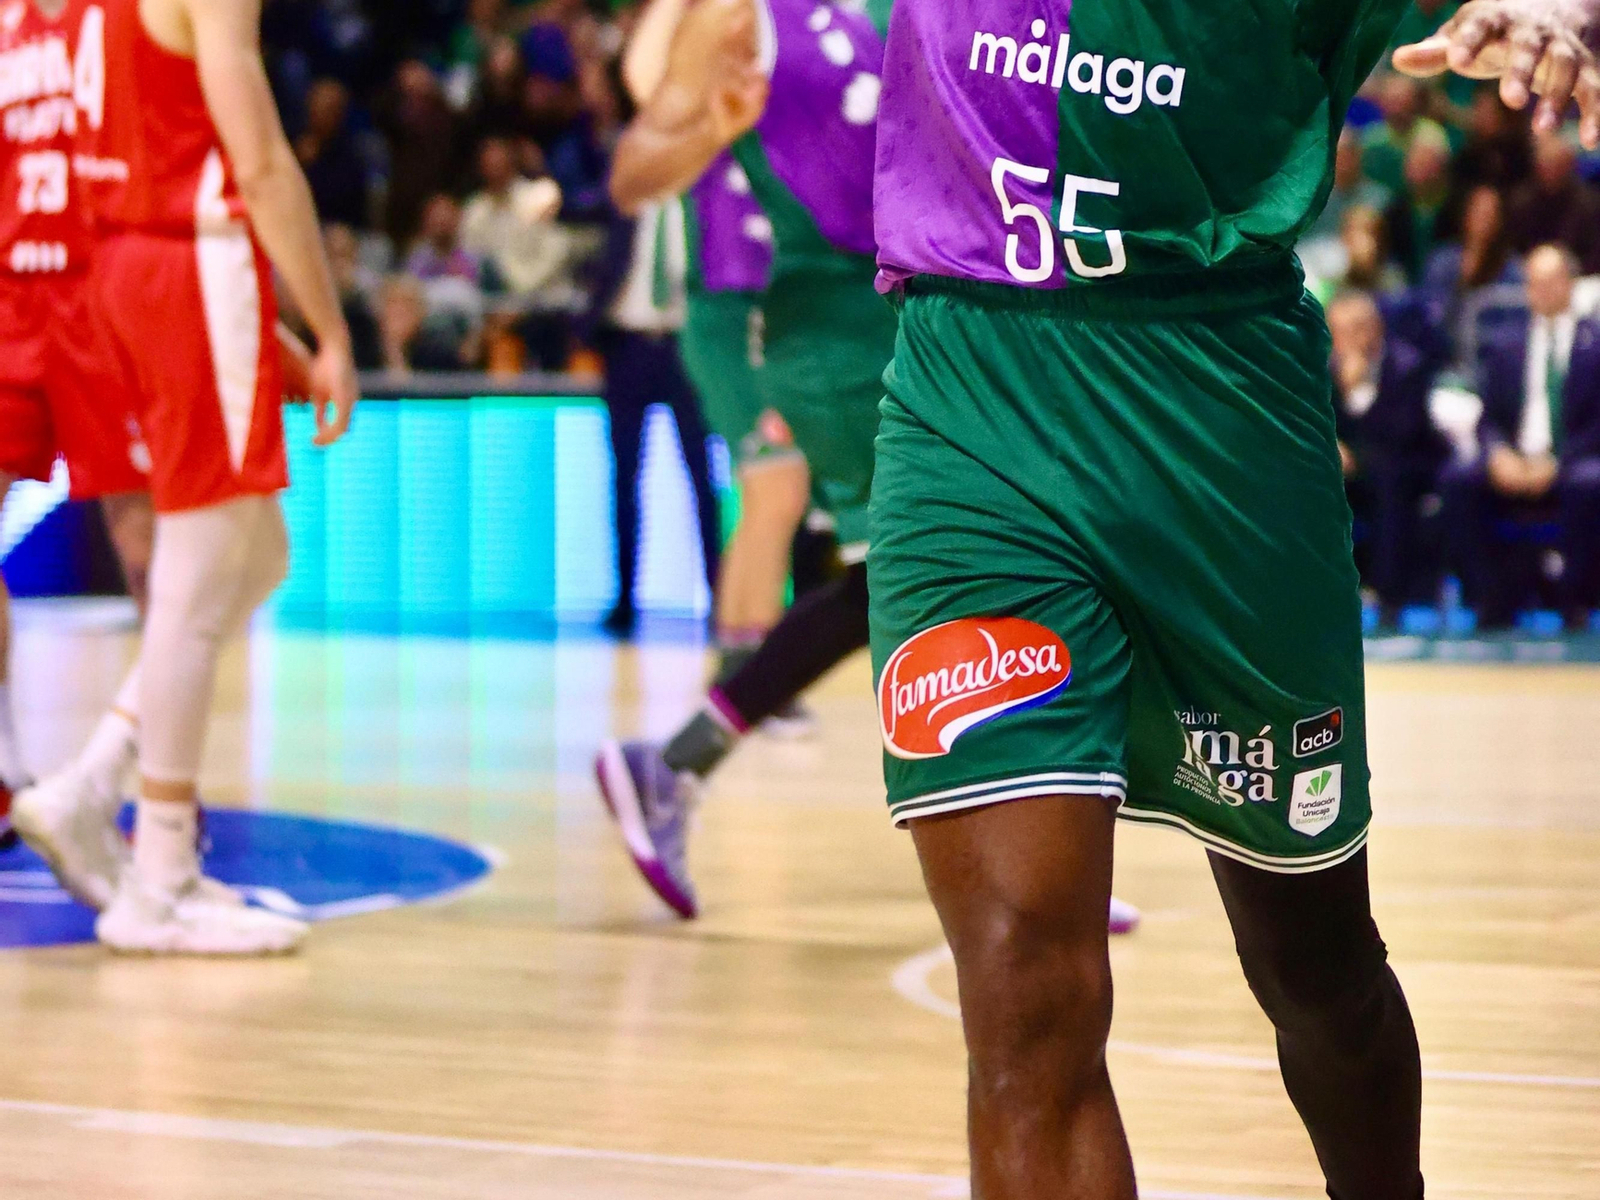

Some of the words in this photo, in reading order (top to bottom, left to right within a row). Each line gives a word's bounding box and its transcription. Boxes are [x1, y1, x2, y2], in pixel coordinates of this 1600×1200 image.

[991, 156, 1128, 283] 55
[889, 627, 1062, 741] famadesa
[1173, 705, 1221, 725] sabor
[1301, 728, 1333, 751] acb
[1297, 797, 1336, 809] Fundación
[1302, 807, 1330, 817] Unicaja
